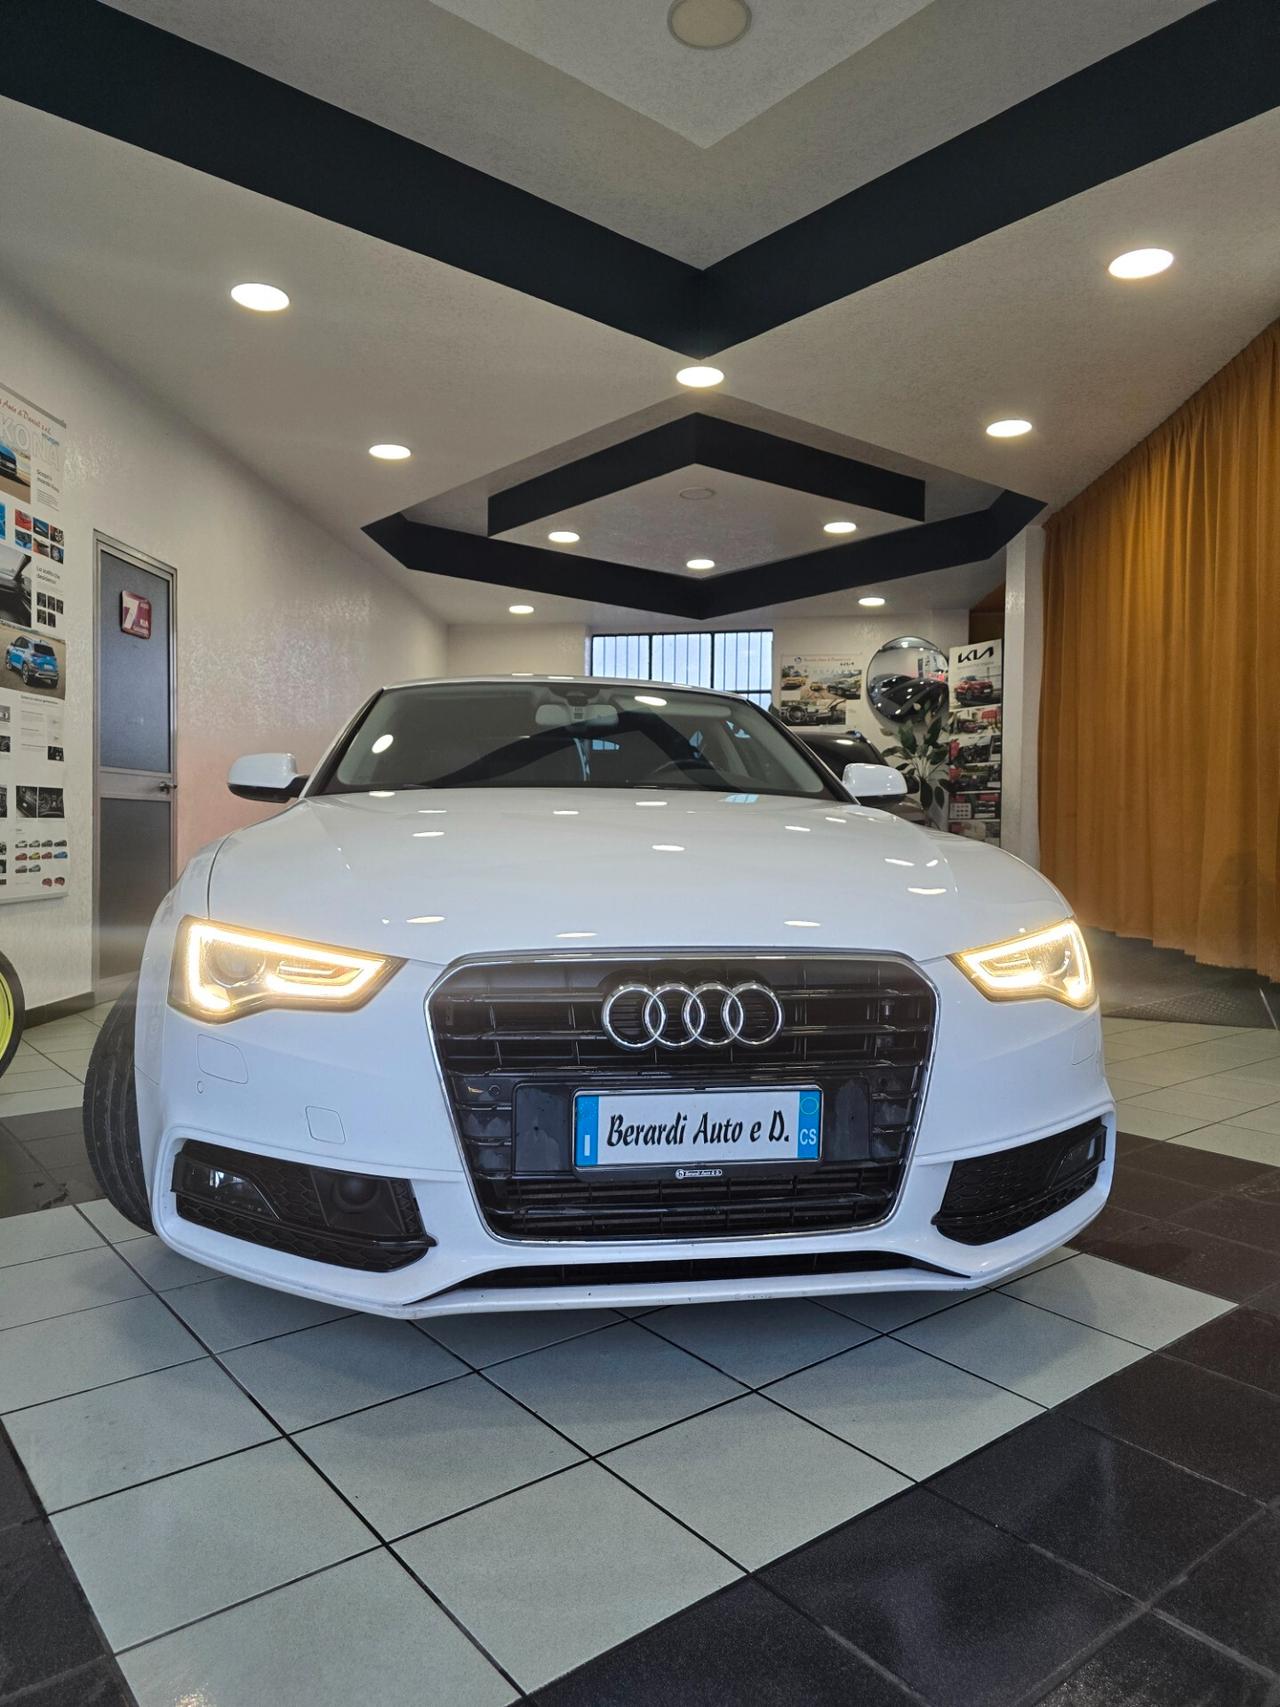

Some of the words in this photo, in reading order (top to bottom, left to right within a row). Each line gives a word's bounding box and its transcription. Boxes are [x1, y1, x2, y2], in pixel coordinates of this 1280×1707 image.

[958, 646, 994, 663] KIA
[607, 1111, 687, 1147] Berardi
[693, 1111, 743, 1145] Auto
[750, 1120, 761, 1143] e
[769, 1110, 790, 1143] D.
[800, 1128, 817, 1146] CS
[584, 1134, 591, 1157] I
